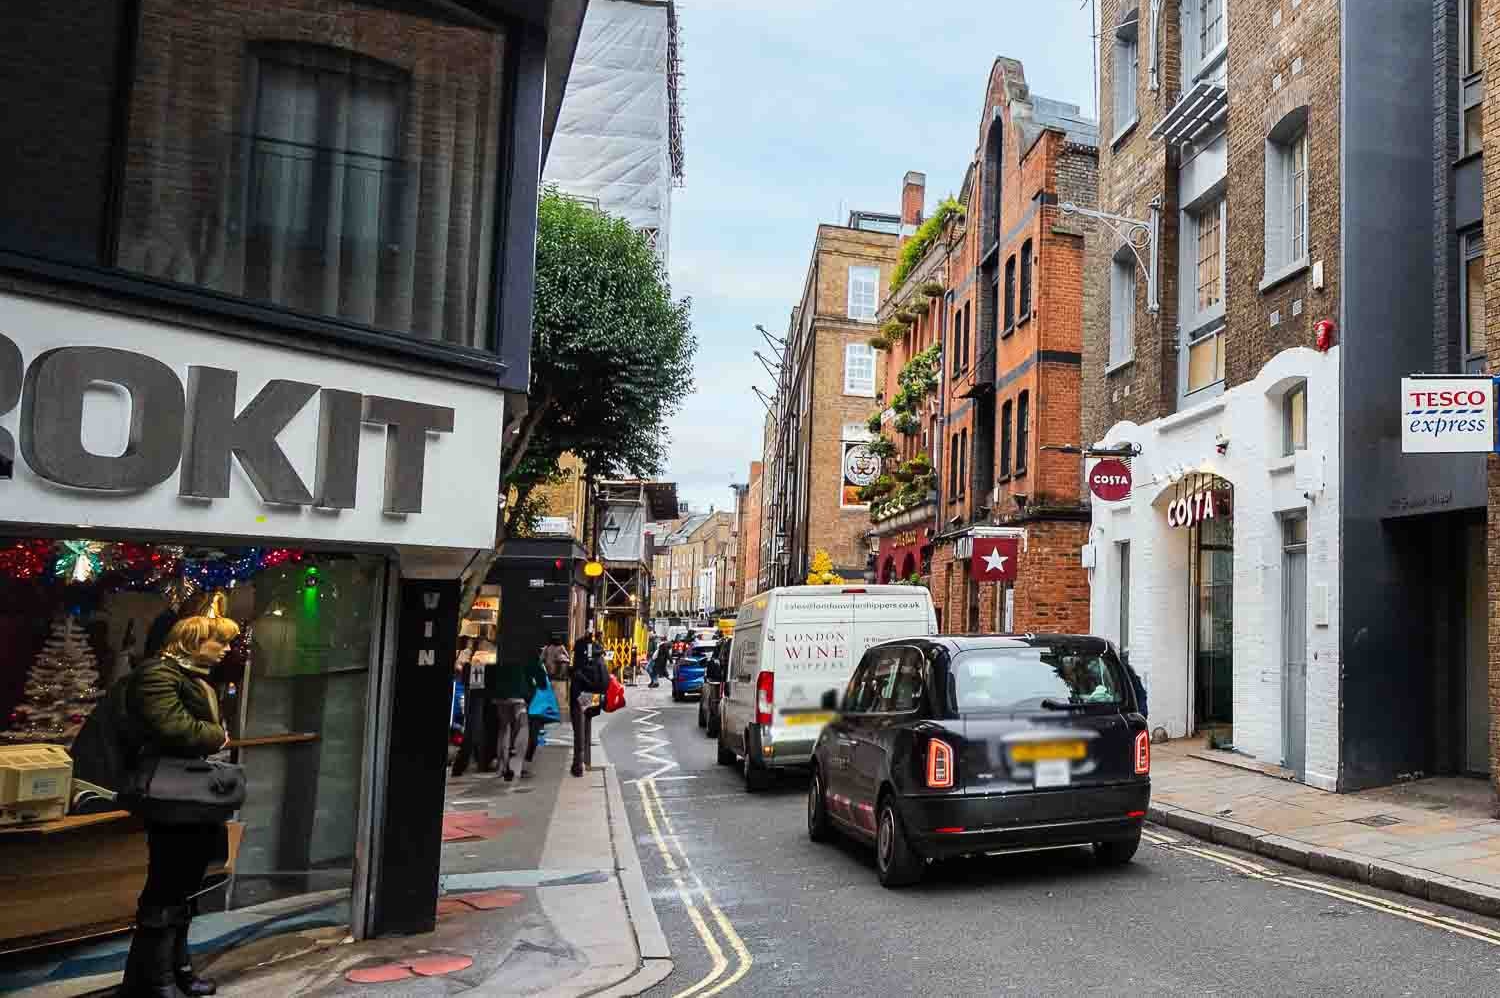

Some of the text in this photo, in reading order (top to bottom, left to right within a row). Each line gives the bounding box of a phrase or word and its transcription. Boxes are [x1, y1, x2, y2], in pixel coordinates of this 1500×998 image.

[1409, 390, 1486, 407] TESCO
[0, 331, 455, 516] OKIT
[1409, 417, 1485, 437] express
[1093, 474, 1129, 486] COSTA
[1167, 490, 1214, 528] COSTA
[785, 633, 845, 643] LONDON
[785, 645, 844, 659] WINE
